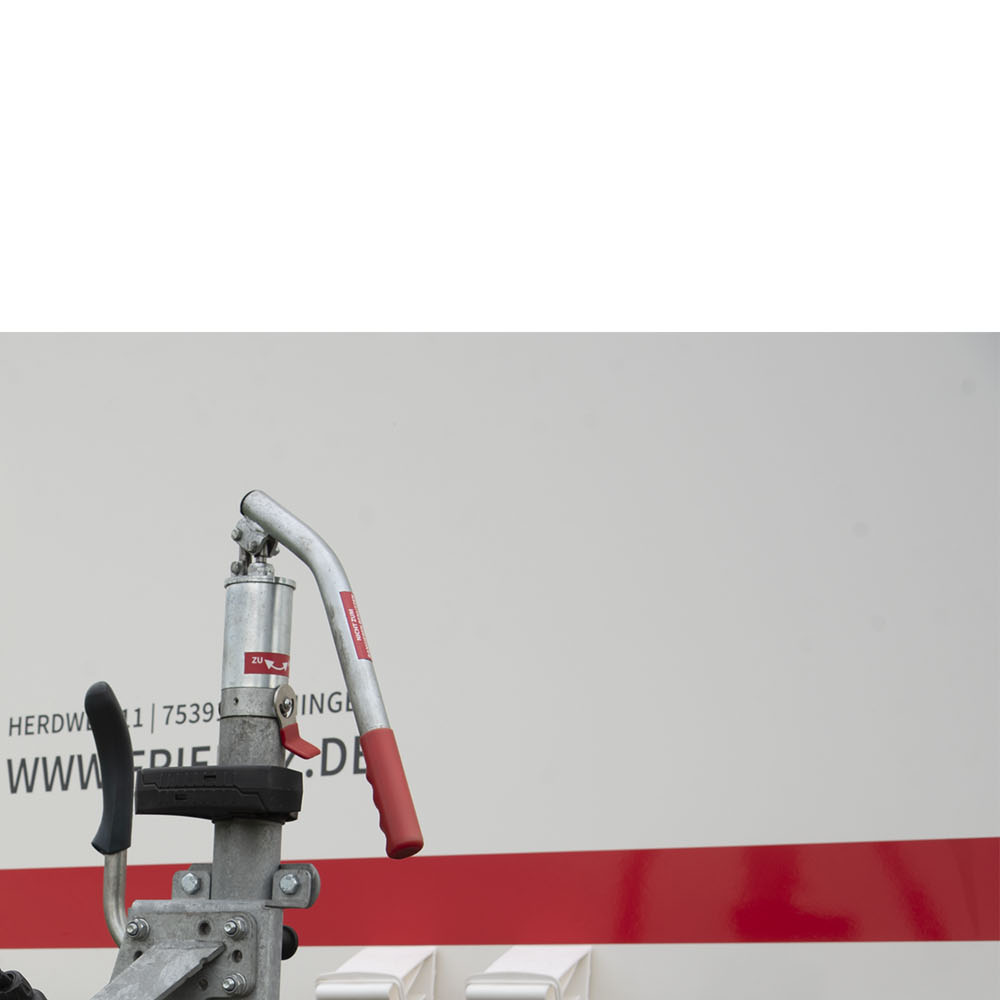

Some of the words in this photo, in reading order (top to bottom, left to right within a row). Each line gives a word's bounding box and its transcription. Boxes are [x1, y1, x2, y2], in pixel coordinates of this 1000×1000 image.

[251, 656, 264, 664] ZU
[8, 711, 93, 736] HERDW
[162, 702, 221, 726] 7539
